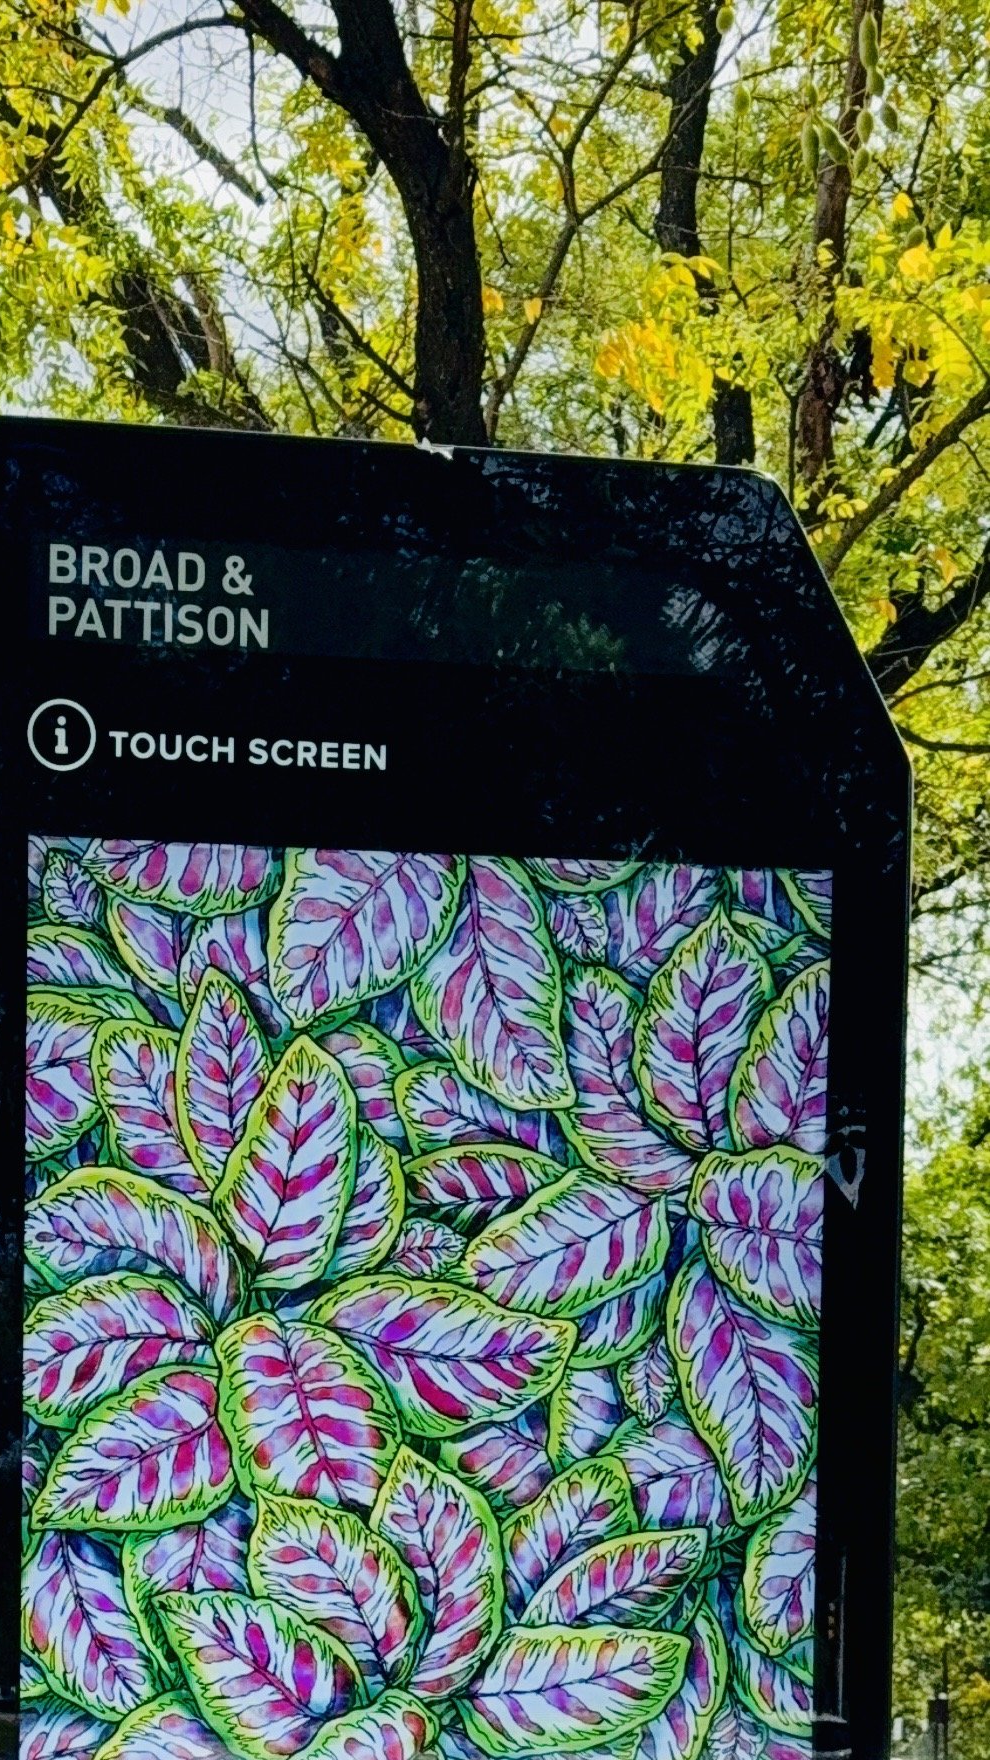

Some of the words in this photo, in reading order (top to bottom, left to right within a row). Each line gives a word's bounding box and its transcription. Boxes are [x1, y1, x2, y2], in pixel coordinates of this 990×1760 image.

[49, 544, 206, 592] BROAD
[222, 555, 254, 596] &
[48, 597, 269, 649] PATTISON
[108, 730, 235, 764] TOUCH
[248, 737, 387, 771] SCREEN
